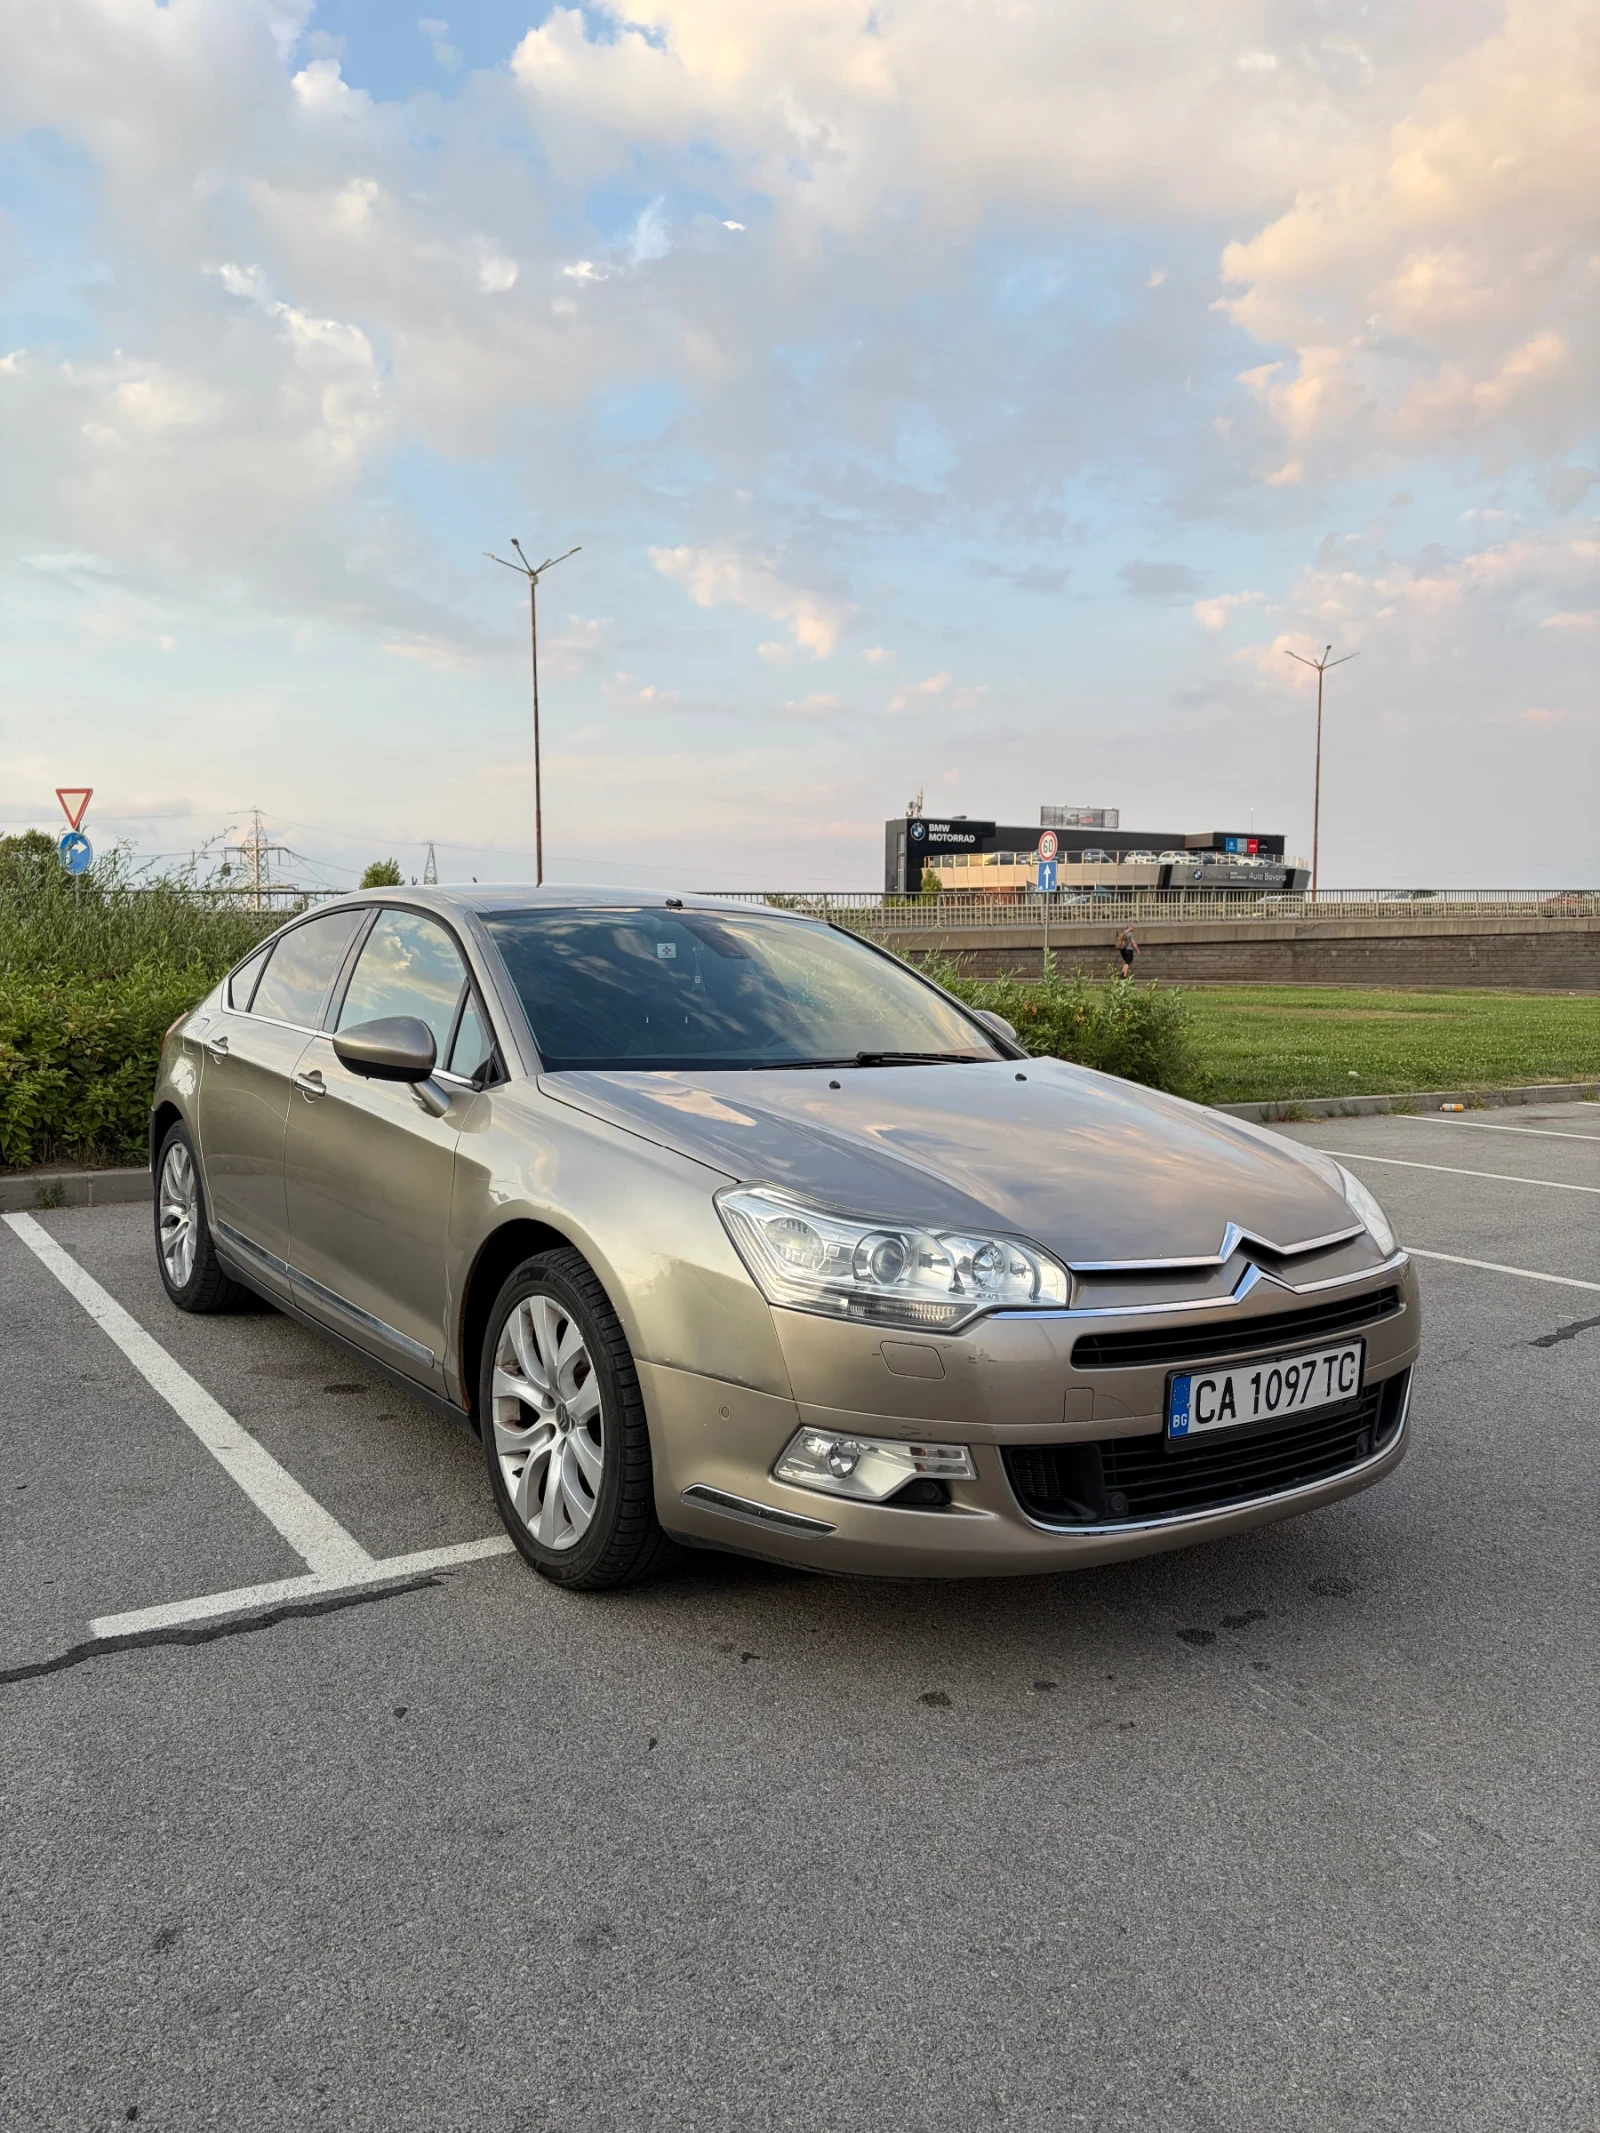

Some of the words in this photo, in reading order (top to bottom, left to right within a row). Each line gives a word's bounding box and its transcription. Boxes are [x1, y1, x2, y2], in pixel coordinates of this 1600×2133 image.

[928, 823, 951, 833] BMW
[928, 833, 976, 843] MOTORRAD
[1043, 838, 1054, 854] 60
[1249, 872, 1264, 881] Auto
[1195, 1376, 1237, 1424] CA
[1250, 1359, 1317, 1415] 1097
[1323, 1351, 1356, 1397] TC
[1172, 1413, 1188, 1428] BG
